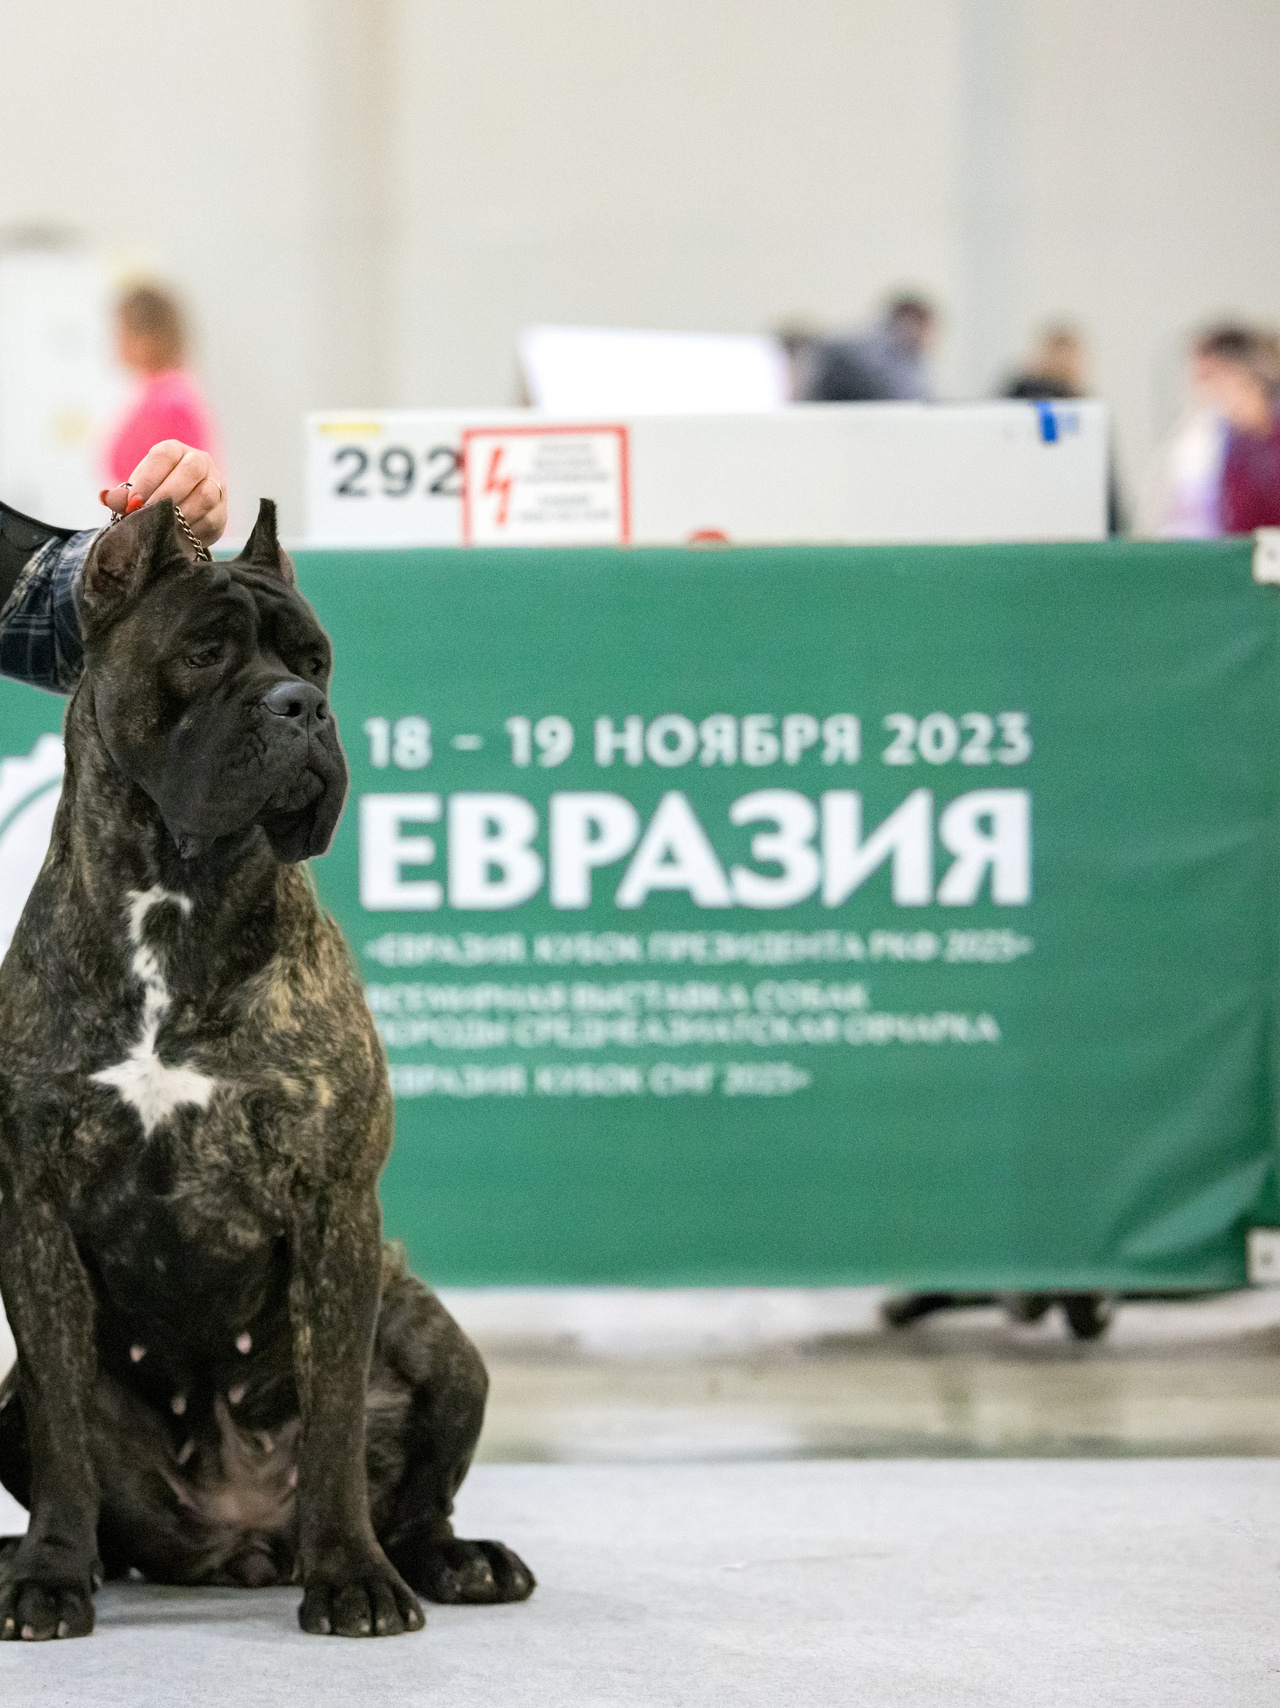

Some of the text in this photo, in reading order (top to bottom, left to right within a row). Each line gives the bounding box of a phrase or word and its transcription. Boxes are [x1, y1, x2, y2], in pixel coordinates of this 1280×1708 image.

[364, 714, 433, 770] 18
[506, 714, 574, 769] 19
[595, 713, 862, 768] НОЯБРЯ
[883, 711, 1031, 767] 2023
[358, 787, 1031, 911] ЕВРАЗИЯ
